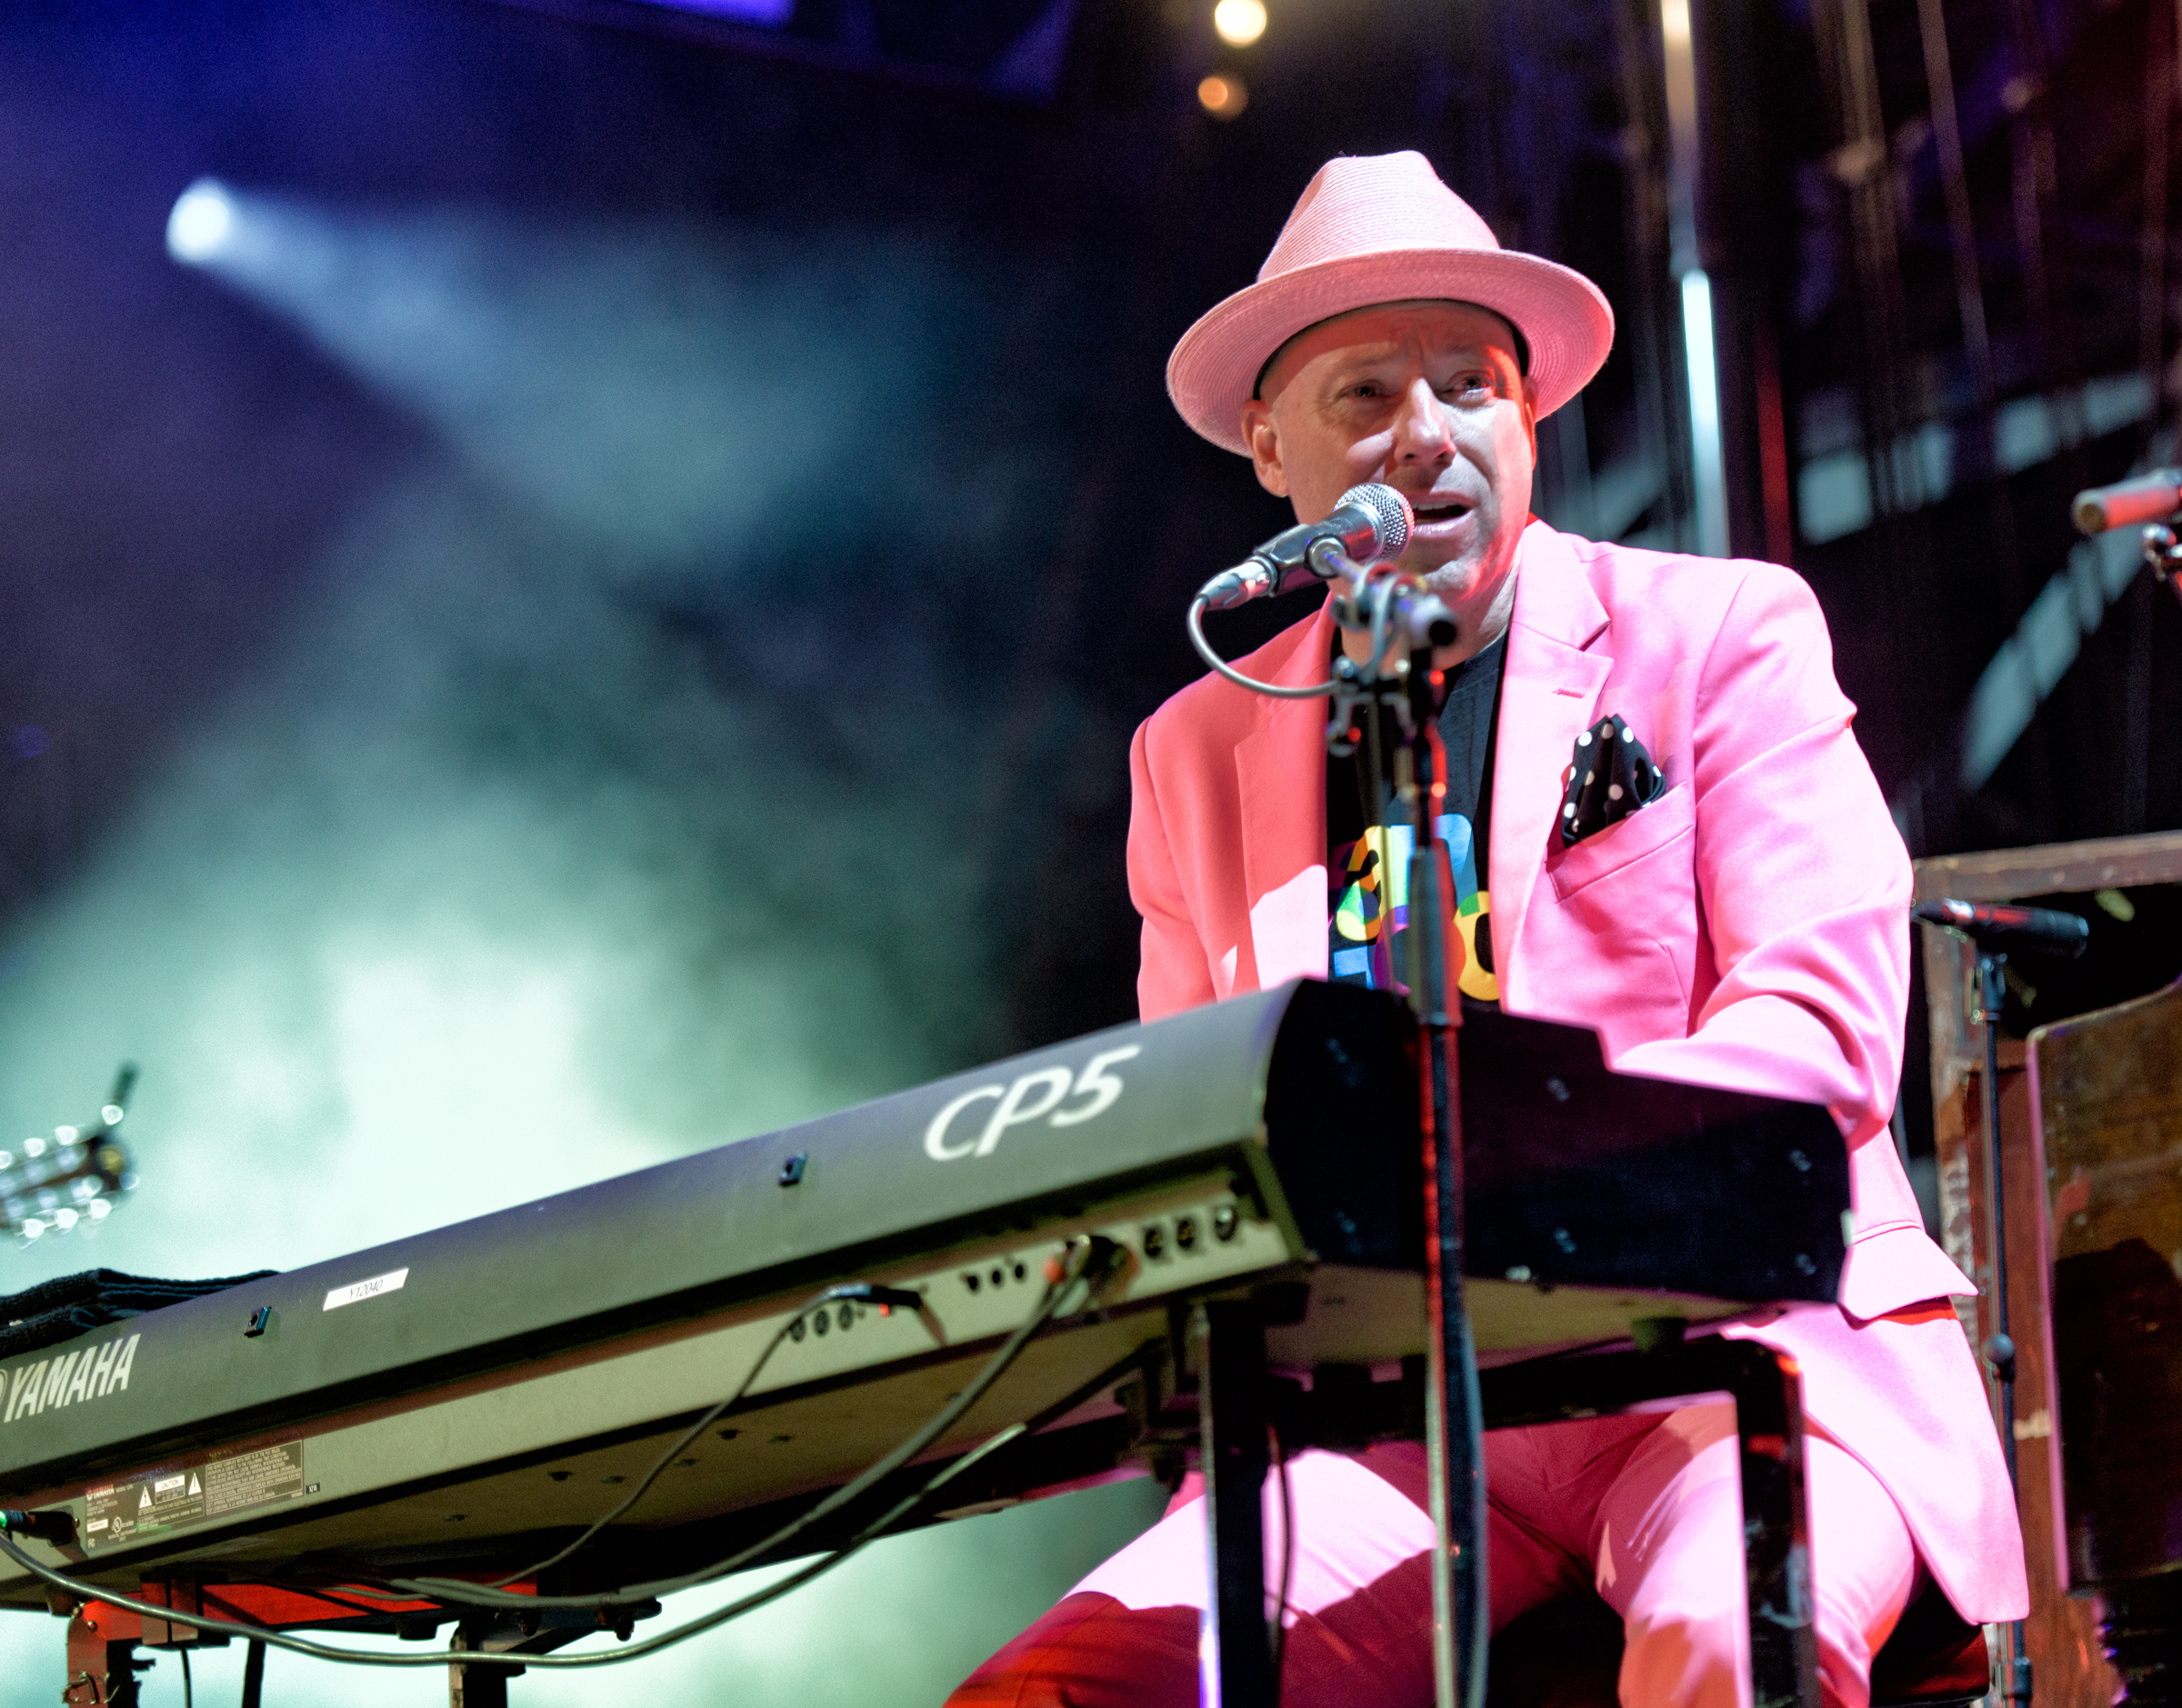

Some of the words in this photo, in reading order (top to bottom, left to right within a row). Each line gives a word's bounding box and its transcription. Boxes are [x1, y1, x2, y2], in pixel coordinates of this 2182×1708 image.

[924, 1044, 1143, 1162] CP5
[349, 1279, 384, 1300] Y12040
[4, 1333, 142, 1423] YAMAHA
[161, 1479, 179, 1490] CAUTION
